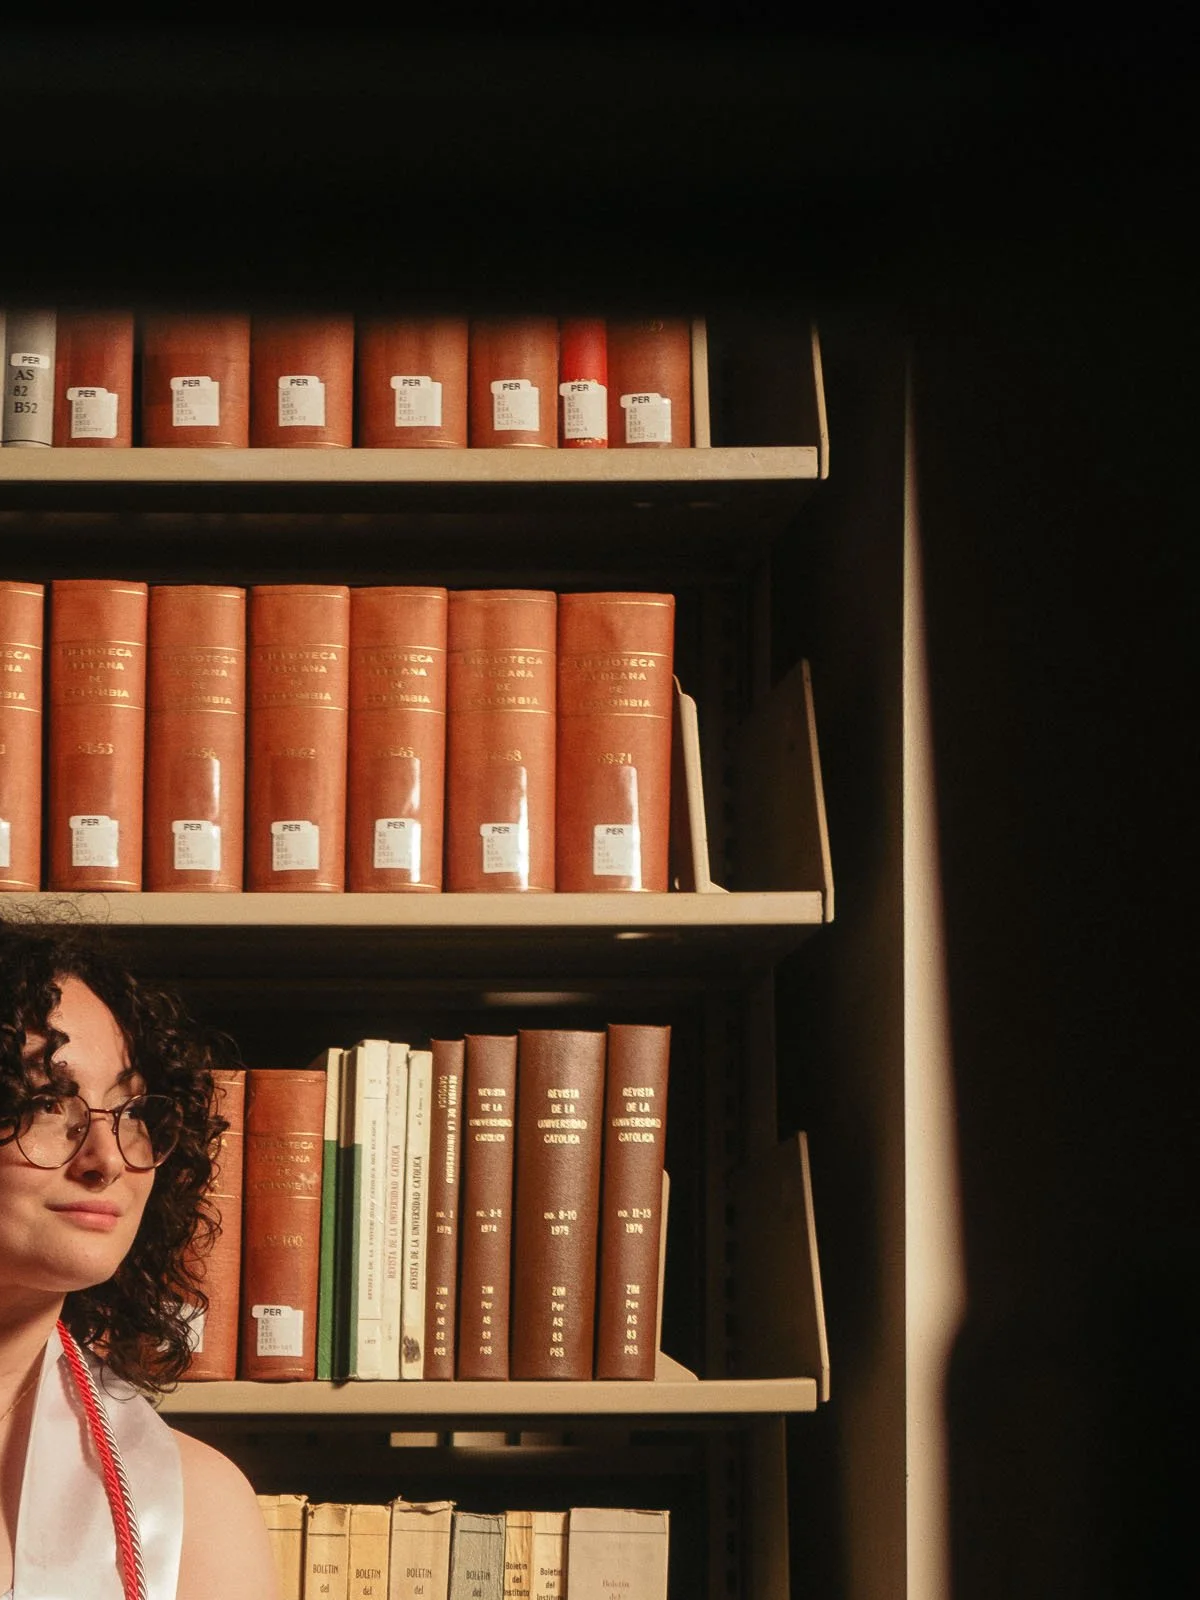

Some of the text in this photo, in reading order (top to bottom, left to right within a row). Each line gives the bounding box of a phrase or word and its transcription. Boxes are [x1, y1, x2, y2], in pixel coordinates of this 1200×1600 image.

[22, 355, 40, 365] PER
[15, 369, 34, 382] AS
[182, 379, 200, 387] PER
[503, 383, 521, 391] PER
[13, 385, 28, 397] 82
[78, 390, 96, 398] PER
[632, 396, 650, 404] PER
[14, 401, 38, 414] B52
[81, 818, 99, 826] PER
[282, 824, 301, 832] PER
[605, 827, 624, 835] PER
[548, 1089, 579, 1098] REVISTA
[622, 1087, 654, 1097] REVISTA
[551, 1104, 575, 1114] DE LA
[626, 1103, 650, 1112] DE LA
[537, 1119, 587, 1129] UNIVERSIDAD
[612, 1118, 661, 1128] UNIVERSIDAD
[544, 1134, 580, 1144] CATOLICA
[618, 1133, 655, 1143] CATOLICA
[410, 1156, 422, 1290] REVISTA DE LA UNIVERSIDAD CATOLICA
[551, 1226, 569, 1235] 1975
[626, 1224, 643, 1234] 1976
[552, 1302, 565, 1312] Per
[626, 1300, 639, 1309] Per
[263, 1308, 282, 1317] PER
[553, 1317, 563, 1327] AS
[627, 1315, 637, 1325] AS
[552, 1333, 563, 1342] 83
[626, 1330, 637, 1340] 83
[313, 1564, 338, 1574] BOLETIN
[356, 1569, 381, 1579] BOLETIN
[407, 1568, 432, 1578] BOLETIN
[512, 1575, 521, 1583] del
[320, 1584, 329, 1593] del
[363, 1586, 372, 1595] del
[414, 1585, 423, 1594] del
